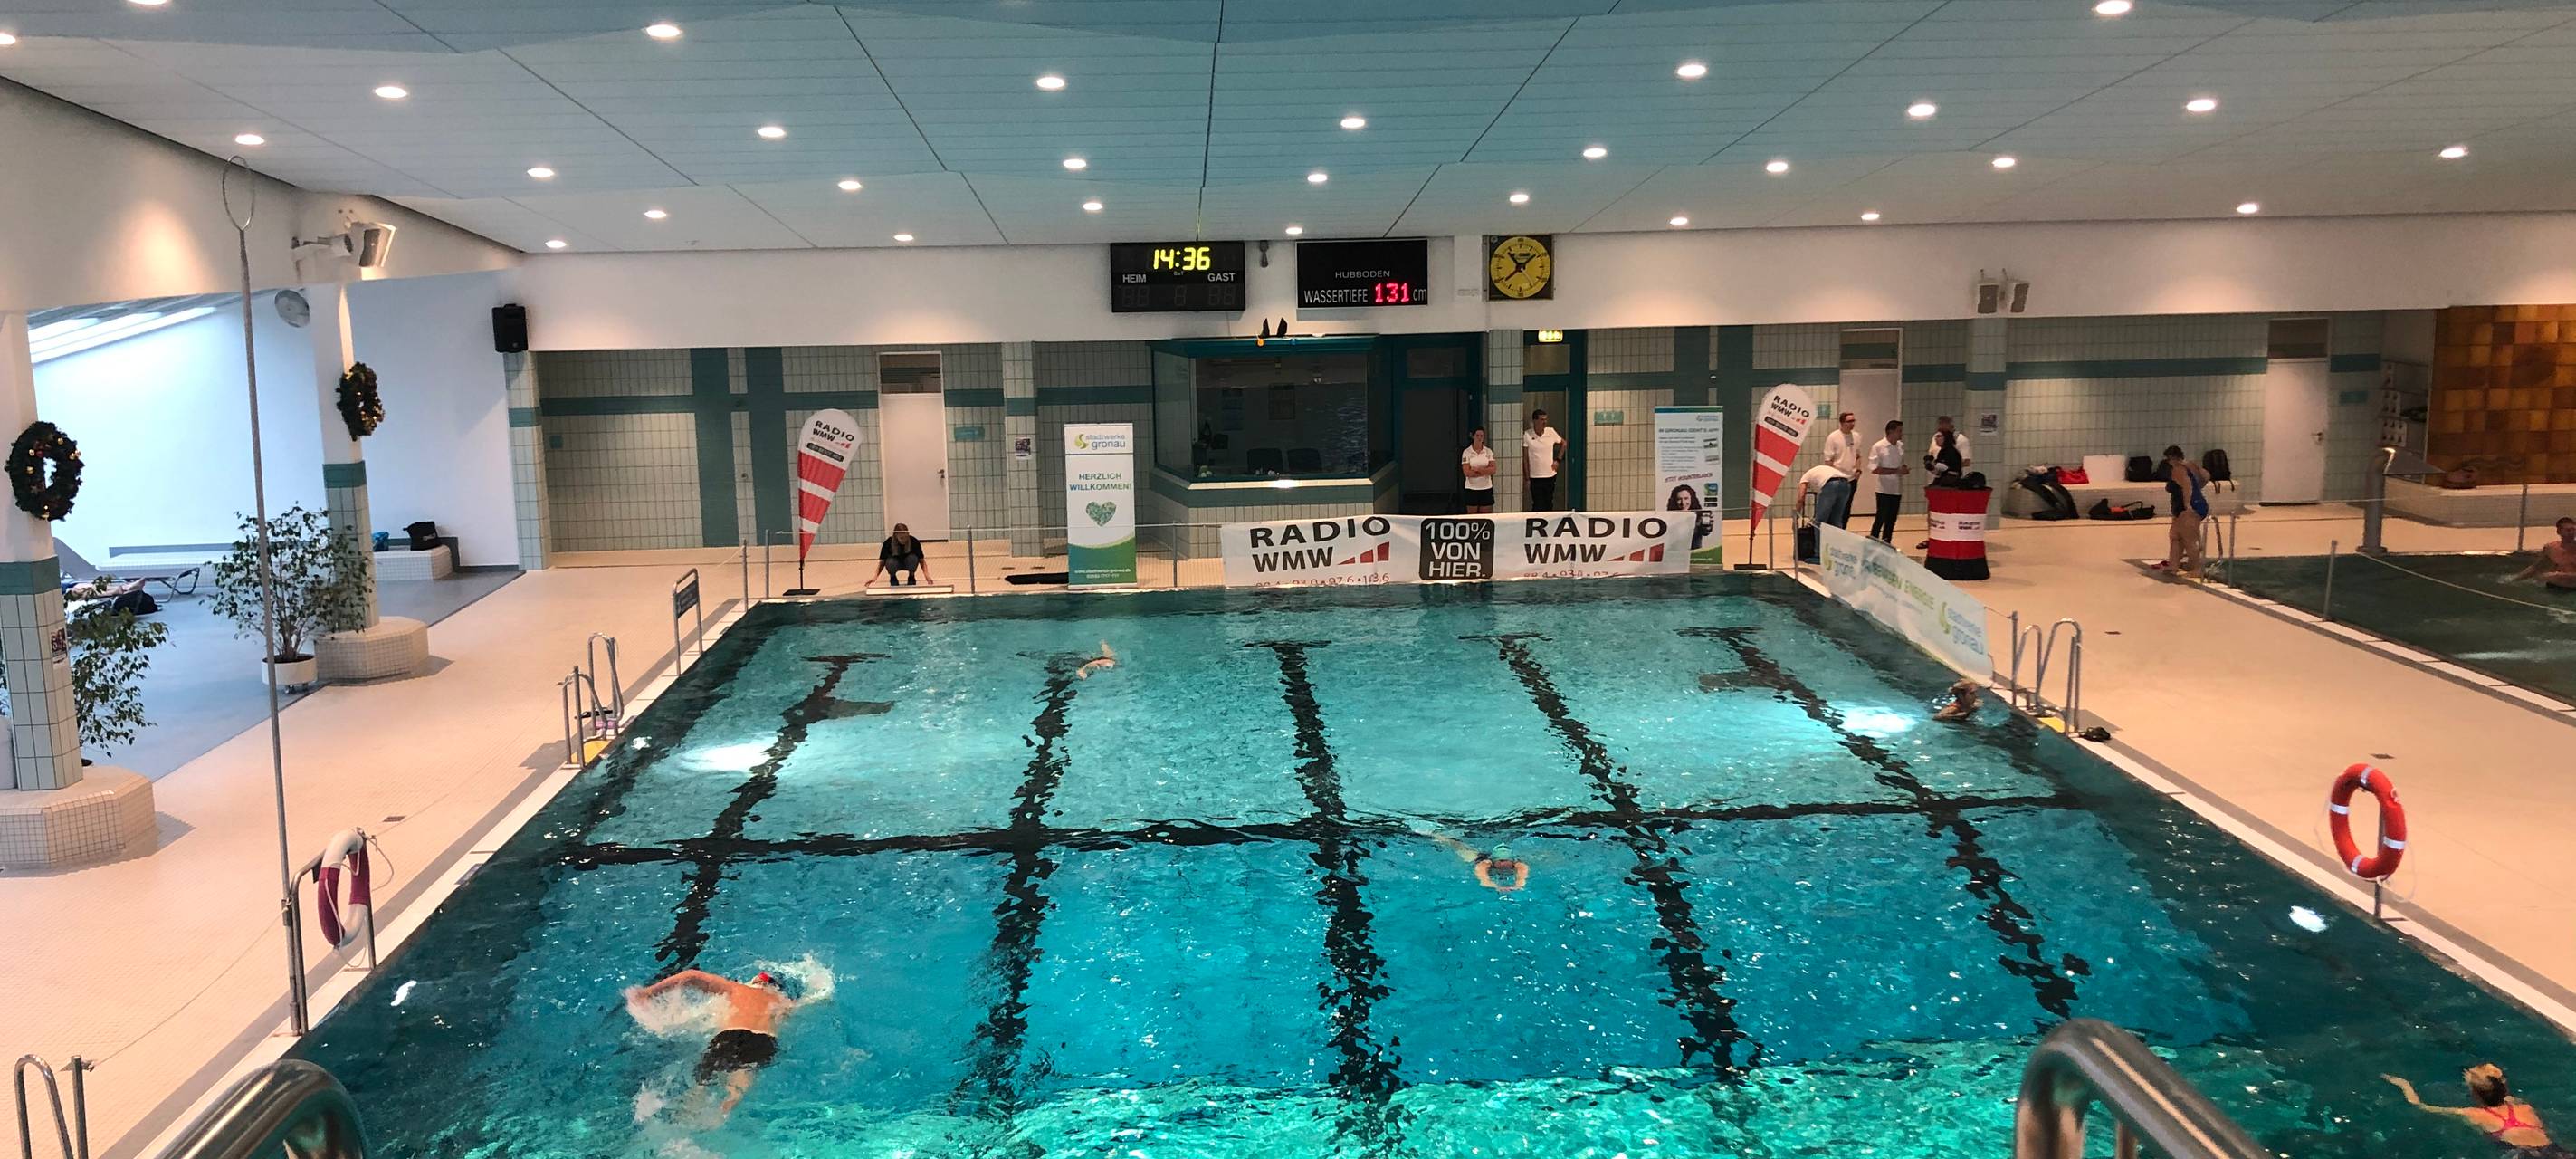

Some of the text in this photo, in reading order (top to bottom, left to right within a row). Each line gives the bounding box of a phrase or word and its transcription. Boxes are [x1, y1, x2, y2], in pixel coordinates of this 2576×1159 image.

[1153, 246, 1211, 271] 14:36
[1122, 273, 1236, 283] HEIM GAST
[1335, 270, 1390, 279] HUBBODEN
[1303, 283, 1427, 303] WASSERTIEFE 131 cm
[1770, 402, 1793, 417] WMW
[1773, 395, 1810, 417] RADIO
[813, 427, 836, 442] WMW
[815, 420, 854, 442] RADIO
[1092, 440, 1126, 450] gronau
[1078, 473, 1122, 481] HERZLICH
[1069, 483, 1131, 491] WILLKOMMEN!
[1250, 516, 1391, 548] RADIO
[1425, 522, 1491, 540] 100%
[1525, 517, 1667, 539] RADIO
[1252, 546, 1334, 572] WMW
[1430, 542, 1481, 560] VON
[1524, 543, 1607, 563] WMW
[1428, 561, 1486, 578] HIER.
